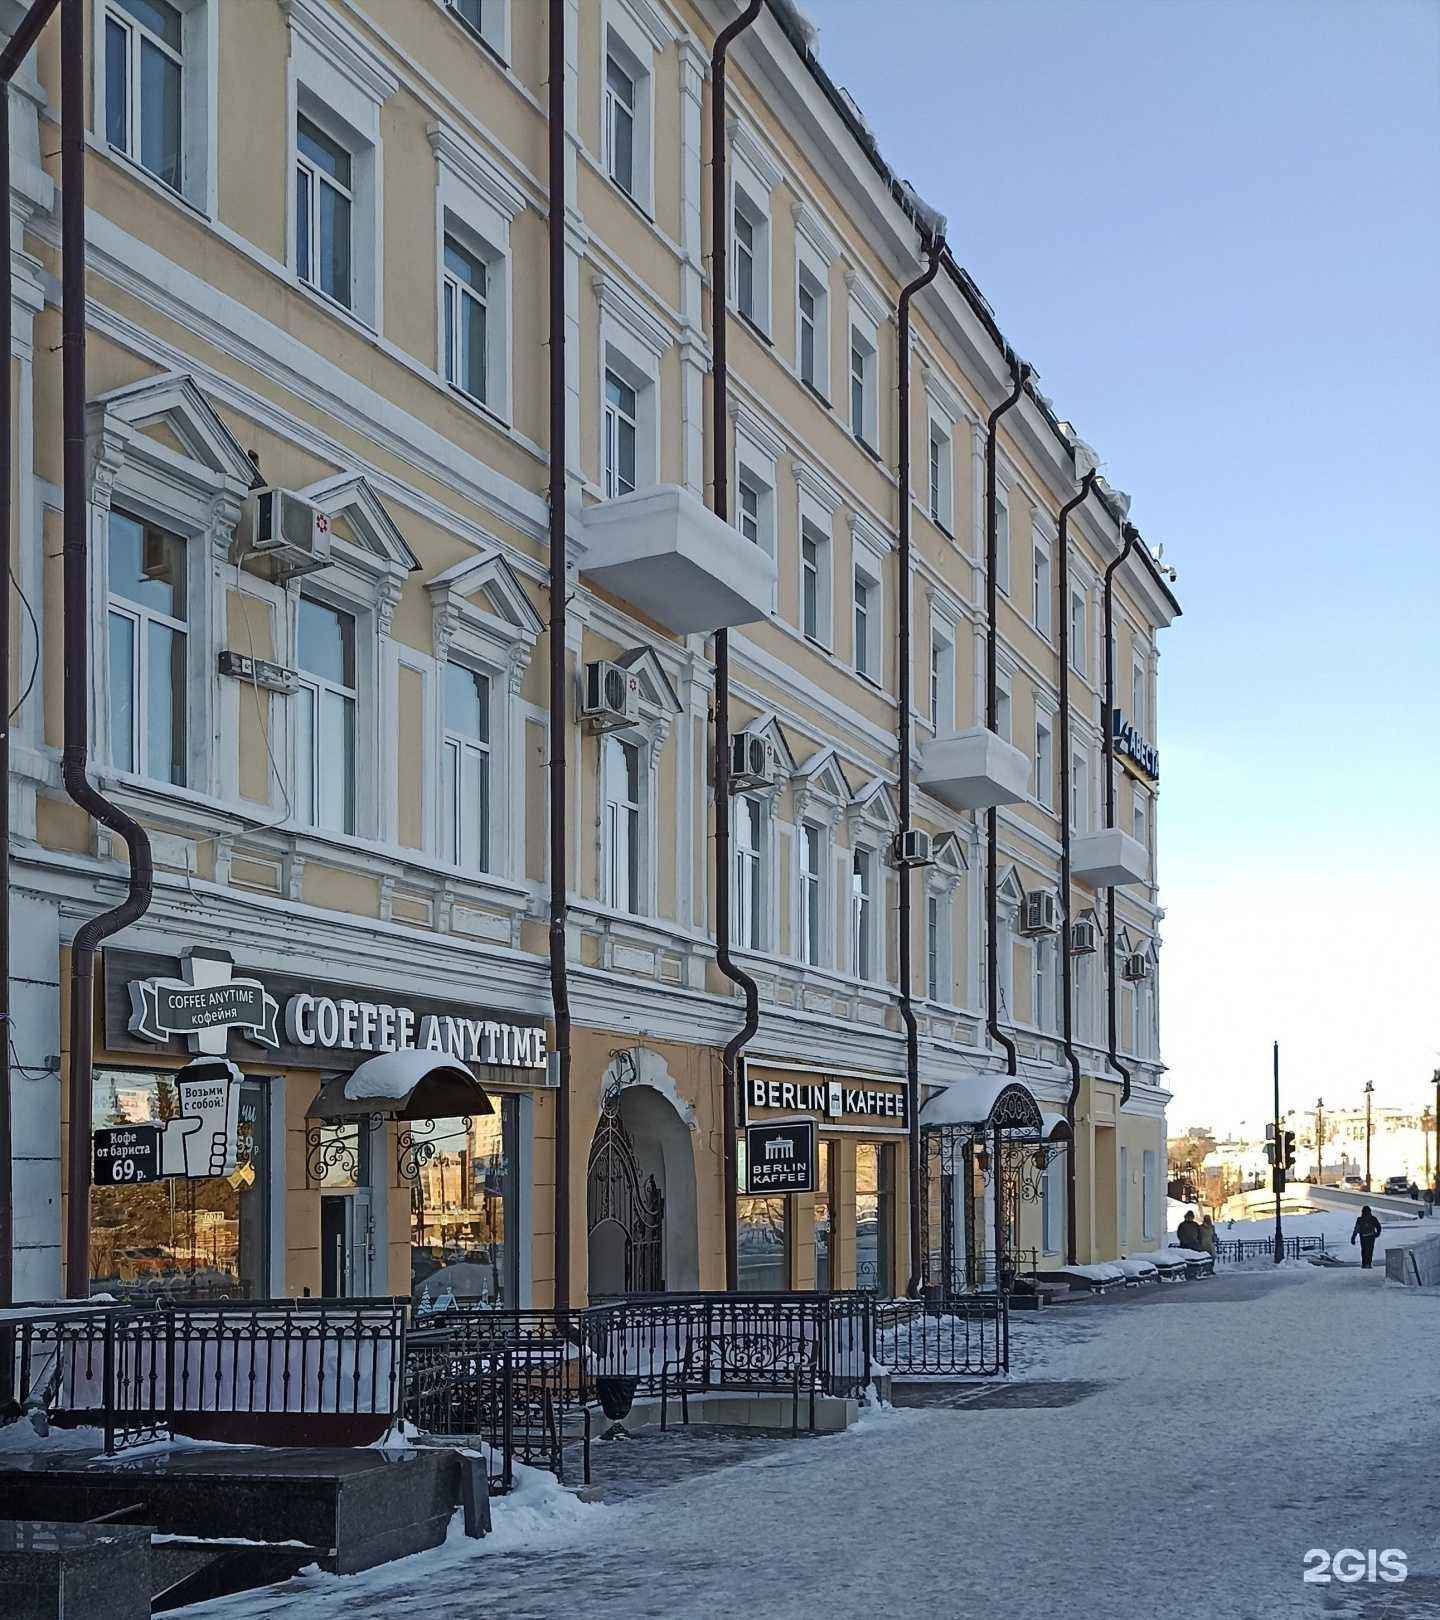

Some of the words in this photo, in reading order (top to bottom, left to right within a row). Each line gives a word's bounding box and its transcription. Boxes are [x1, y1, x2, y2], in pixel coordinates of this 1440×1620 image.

[168, 994, 207, 1009] COFFEE
[209, 989, 254, 1004] ANYTIME
[191, 1007, 237, 1026] кофейня
[290, 994, 416, 1050] COFFEE
[424, 1014, 547, 1068] ANYTIME
[184, 1086, 223, 1098] Возьми
[754, 1079, 825, 1111] BERLIN
[846, 1088, 904, 1117] KAFFEE
[184, 1103, 190, 1111] с
[191, 1098, 224, 1110] собой!
[110, 1132, 137, 1146] Кофе
[97, 1148, 108, 1157] от
[110, 1144, 151, 1158] бариста
[112, 1159, 135, 1181] 69
[136, 1170, 147, 1181] р.
[753, 1162, 807, 1174] BERLIN
[753, 1173, 806, 1184] KAFFEE
